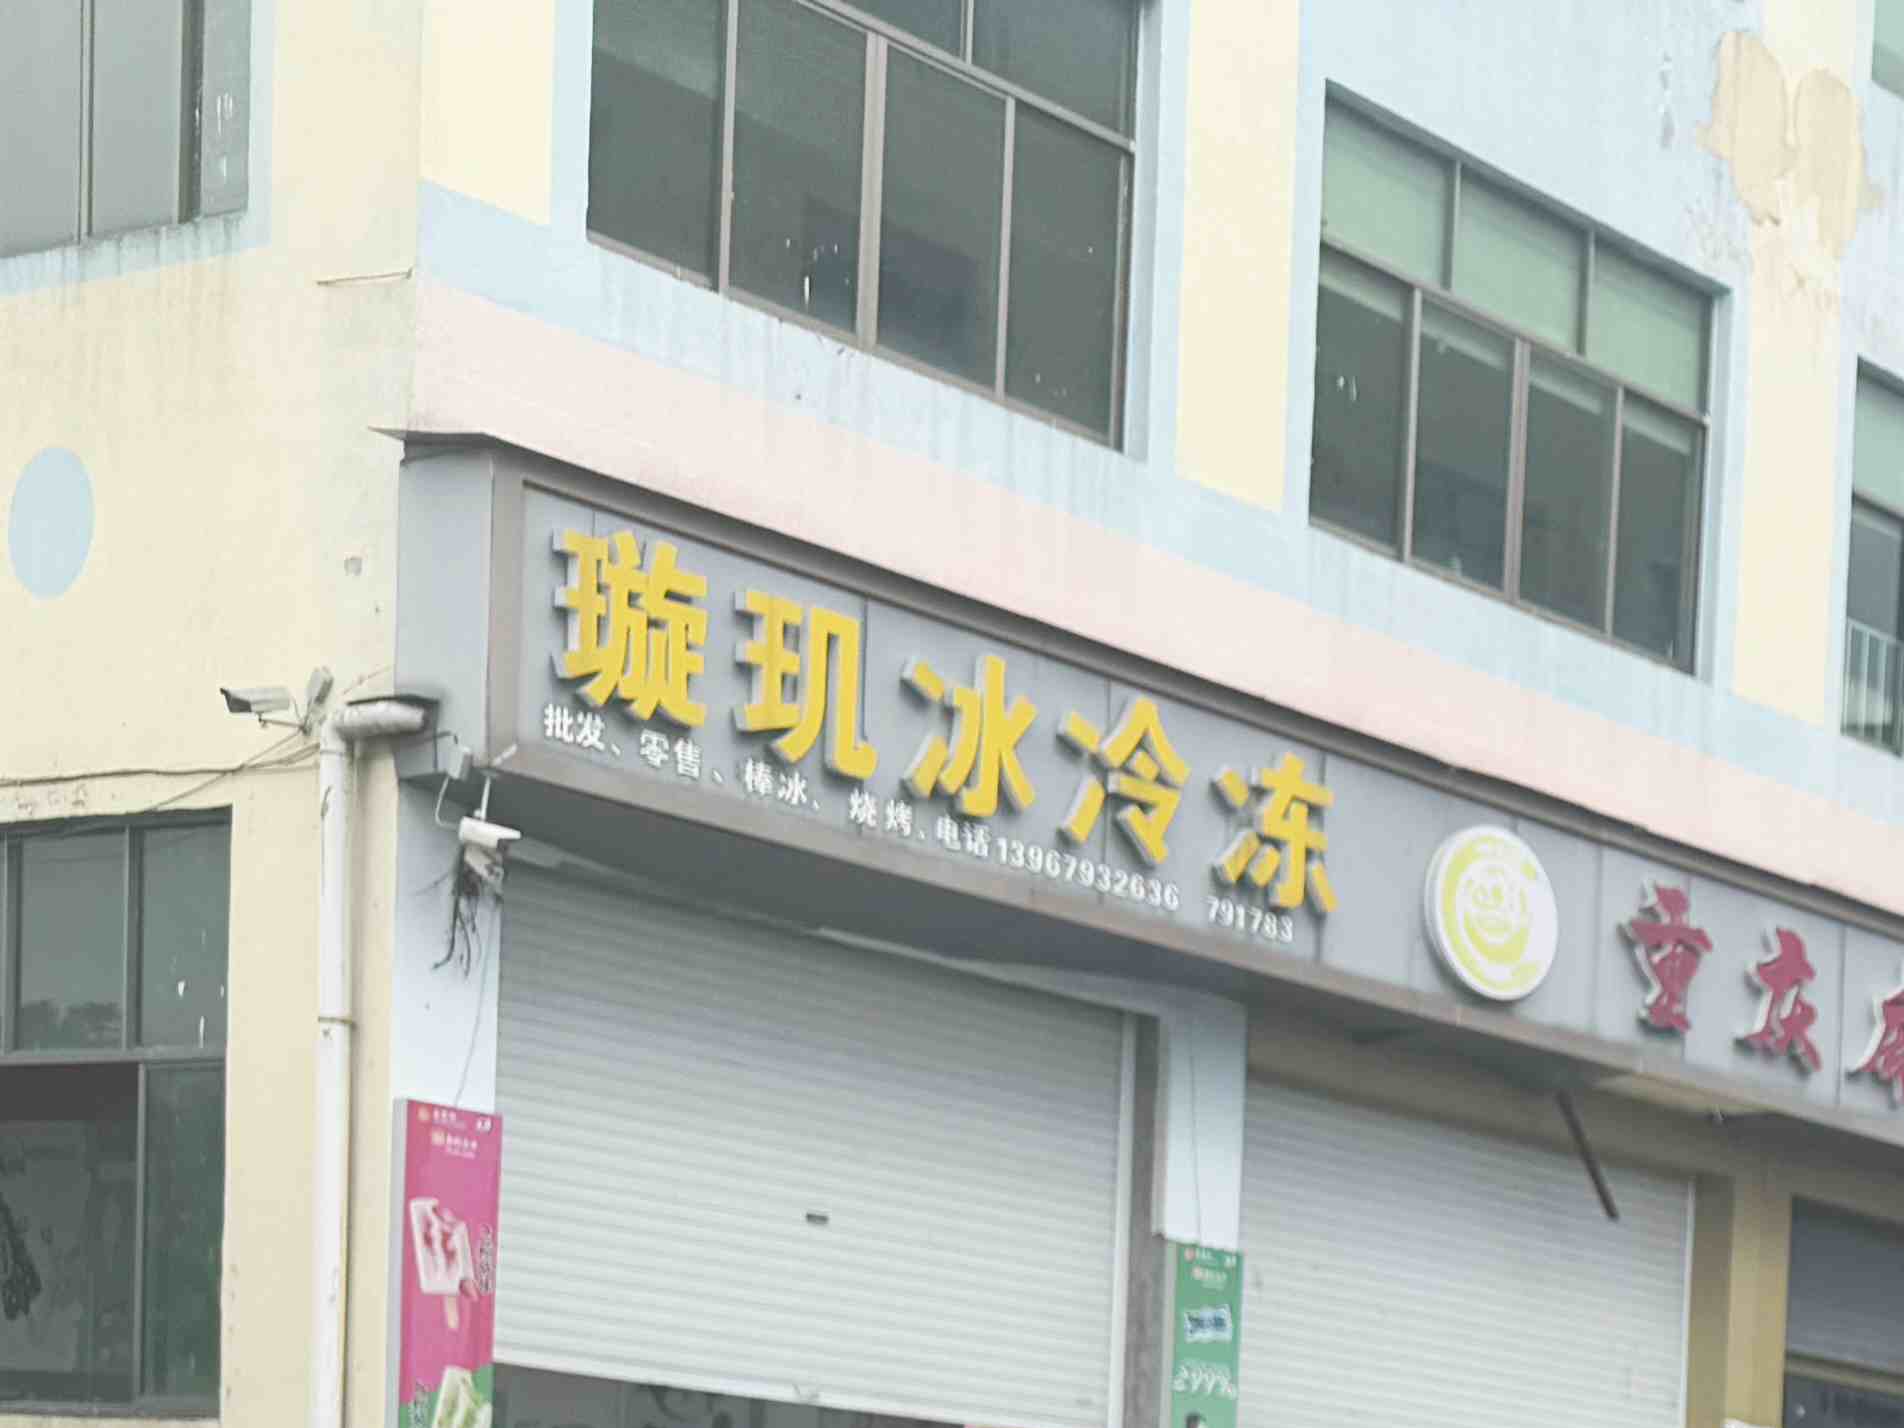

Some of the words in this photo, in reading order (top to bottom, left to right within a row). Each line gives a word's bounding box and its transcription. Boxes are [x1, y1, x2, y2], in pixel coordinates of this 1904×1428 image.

[551, 527, 1339, 914] 璇玑冰冷冻
